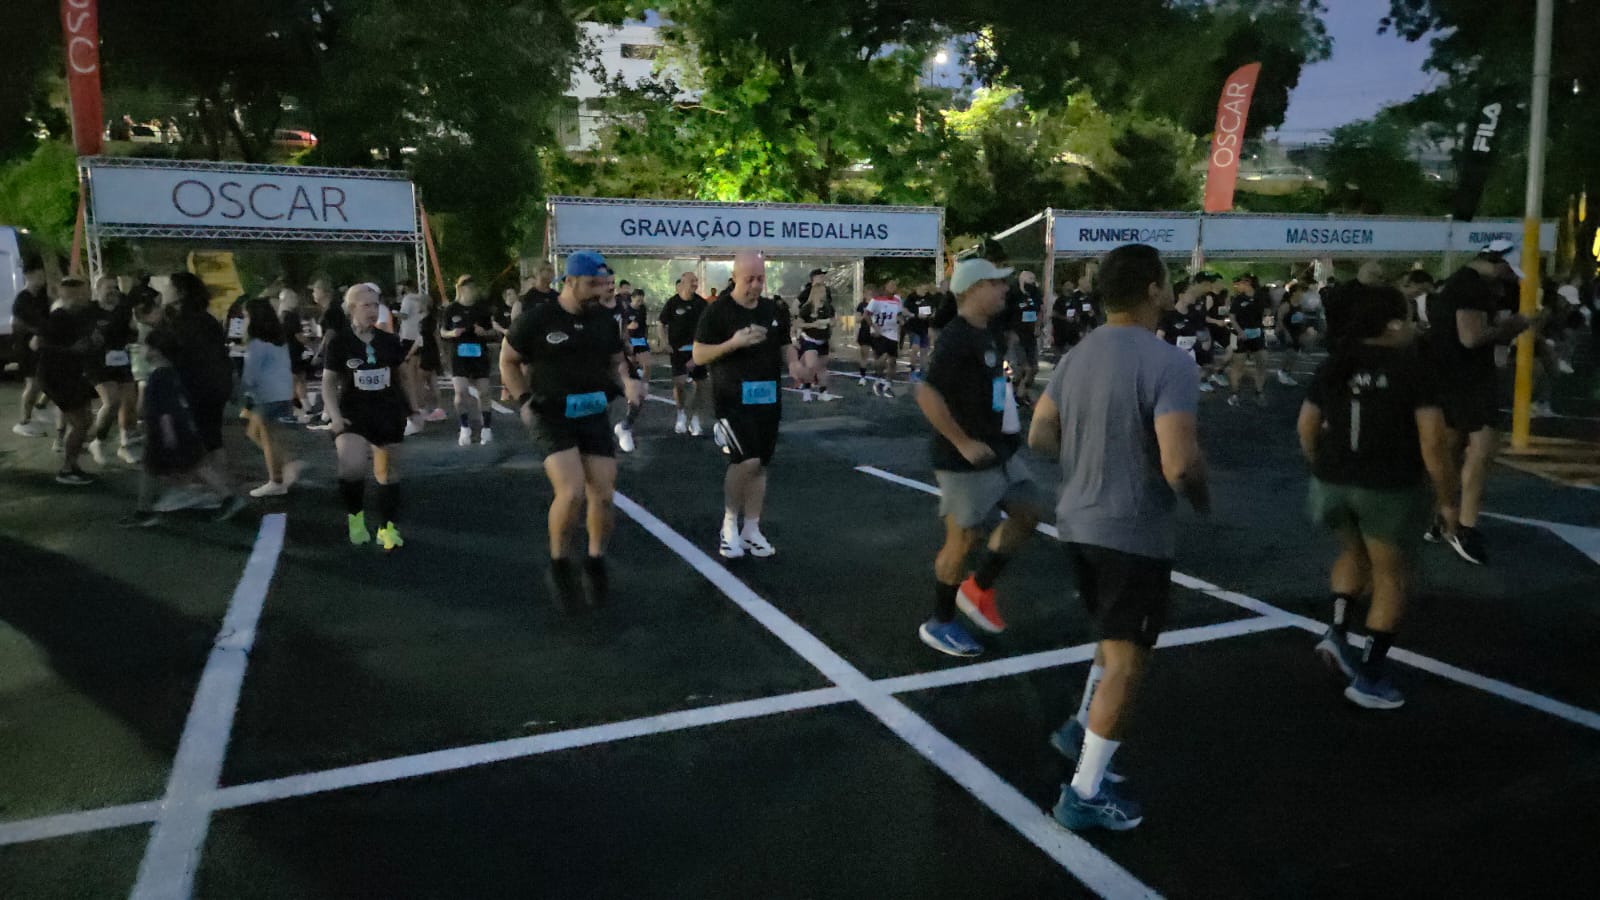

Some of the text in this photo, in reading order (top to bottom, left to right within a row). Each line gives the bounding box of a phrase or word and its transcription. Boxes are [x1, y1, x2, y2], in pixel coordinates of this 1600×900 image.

[1213, 83, 1249, 167] OSCAR
[1472, 103, 1502, 152] FILA
[172, 179, 348, 222] OSCAR
[620, 216, 889, 241] GRAVAÇÃO DE MEDALHAS
[1286, 228, 1374, 244] MASSAGEM
